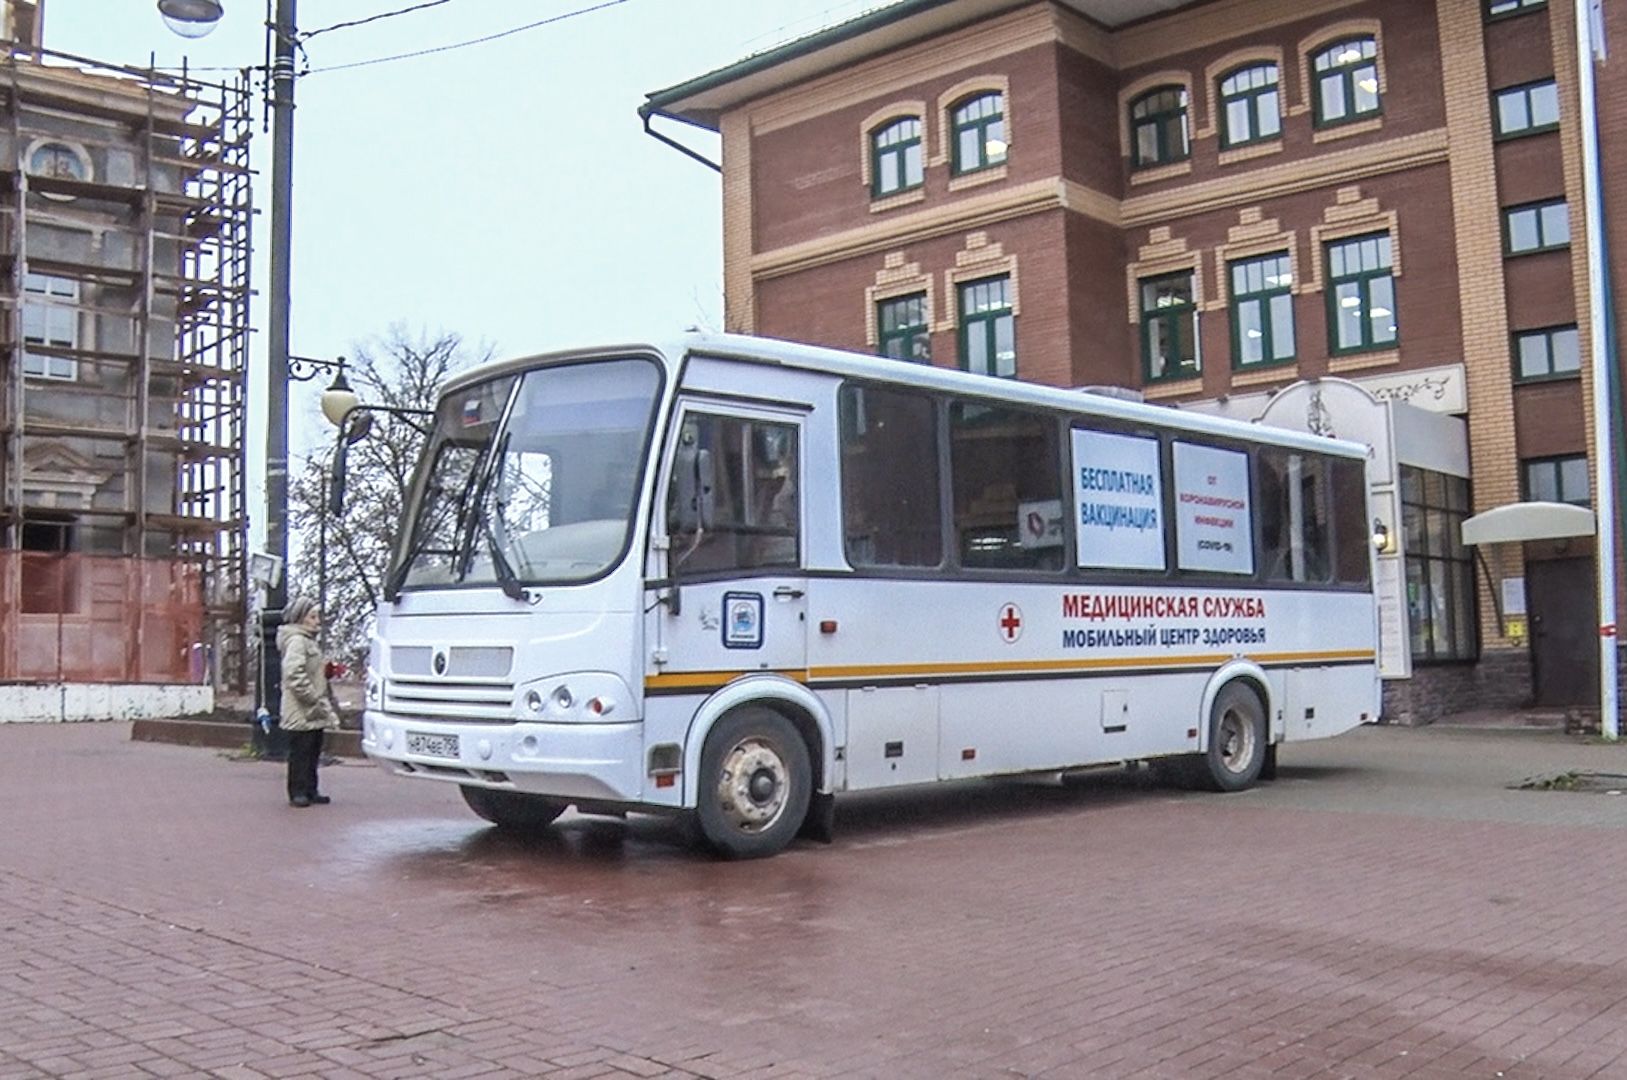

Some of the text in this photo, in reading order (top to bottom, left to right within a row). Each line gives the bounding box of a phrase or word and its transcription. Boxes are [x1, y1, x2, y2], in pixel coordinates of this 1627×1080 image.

[1081, 467, 1155, 496] БЕСПЛАТНАЯ
[1081, 502, 1158, 532] ВАКЦИНАЦИЯ
[1063, 594, 1265, 622] МЕДИЦИНСКАЯ СЛУЖБА
[1063, 623, 1266, 648] МОБИЛЬНЫЙ ЦЕНТР ЗДОРОВЬЯ
